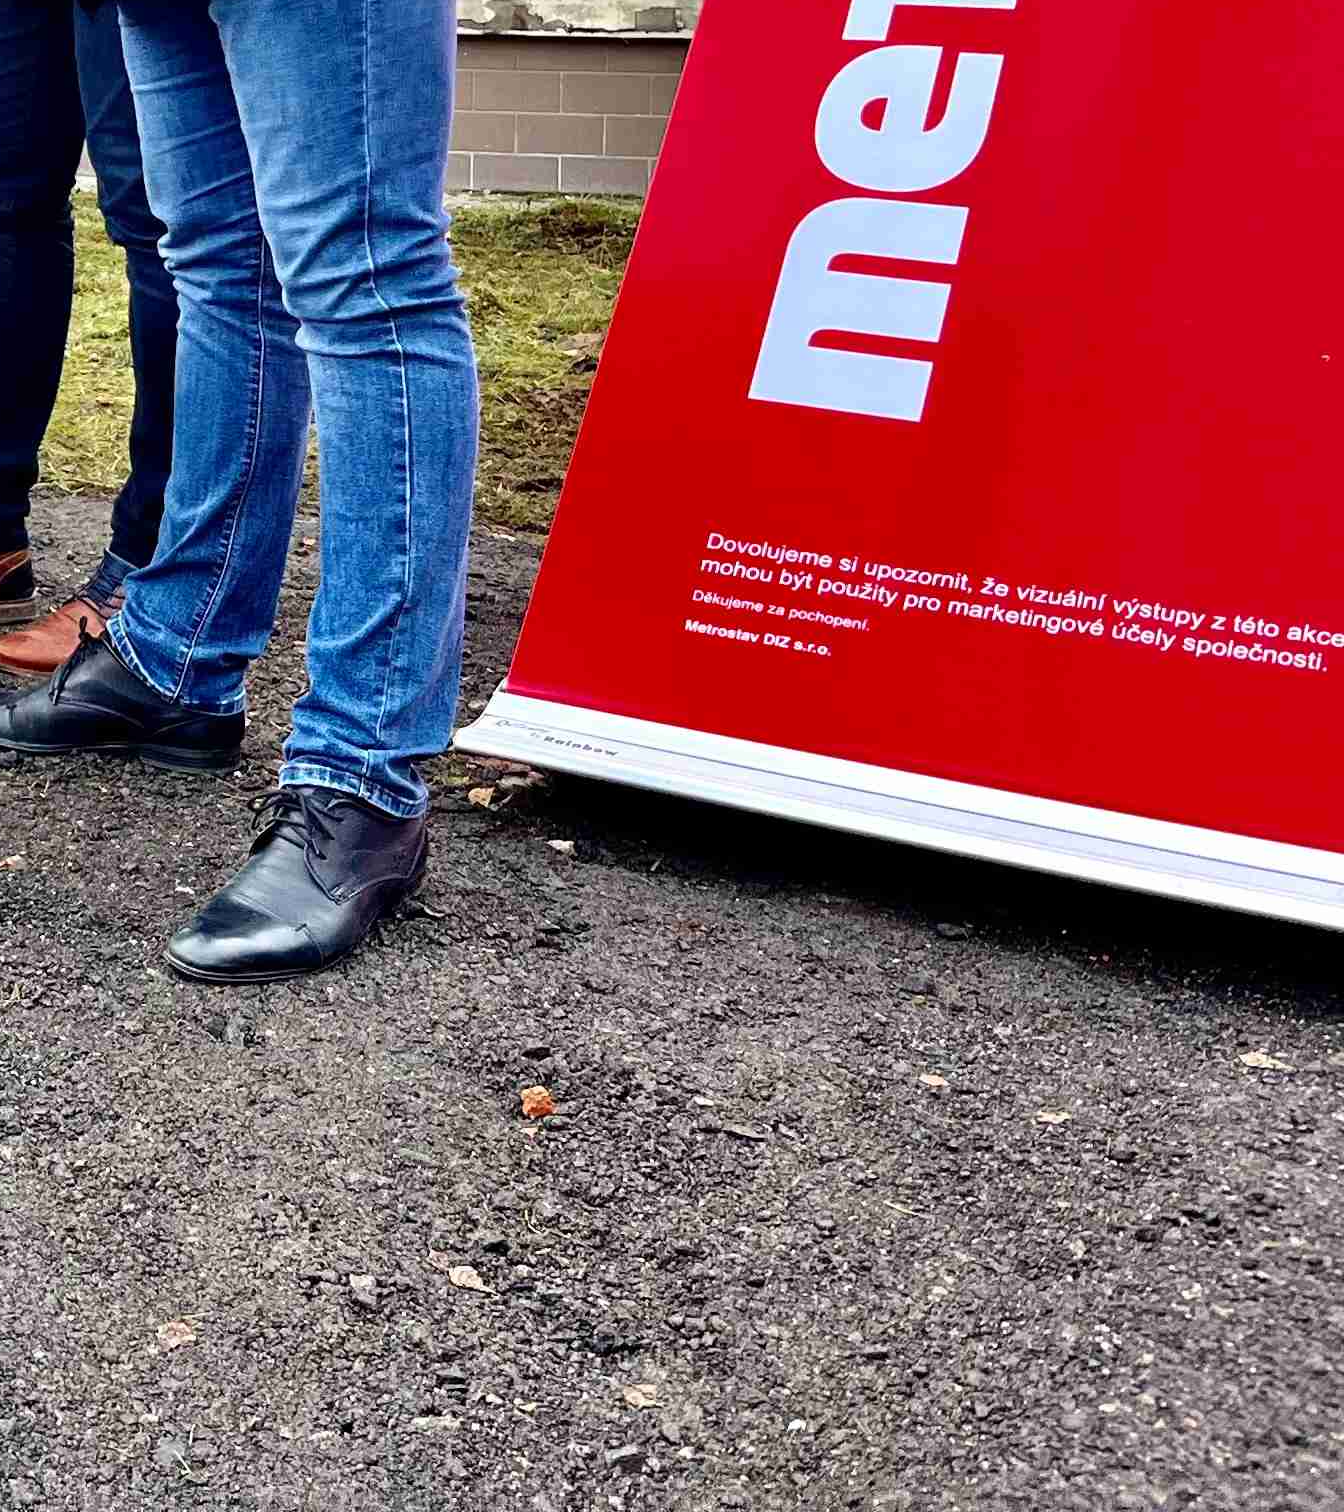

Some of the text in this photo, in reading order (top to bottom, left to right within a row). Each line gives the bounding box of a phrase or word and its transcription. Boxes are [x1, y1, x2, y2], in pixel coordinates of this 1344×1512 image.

[691, 589, 871, 633] Děkujeme za pochopení.
[700, 557, 1329, 673] mohou být použity pro marketingové účely společnosti.
[706, 532, 1344, 649] Dovolujeme si upozornit, že vizuální výstupy z této akce
[684, 619, 833, 657] Metrostav DIZ s.r.o.
